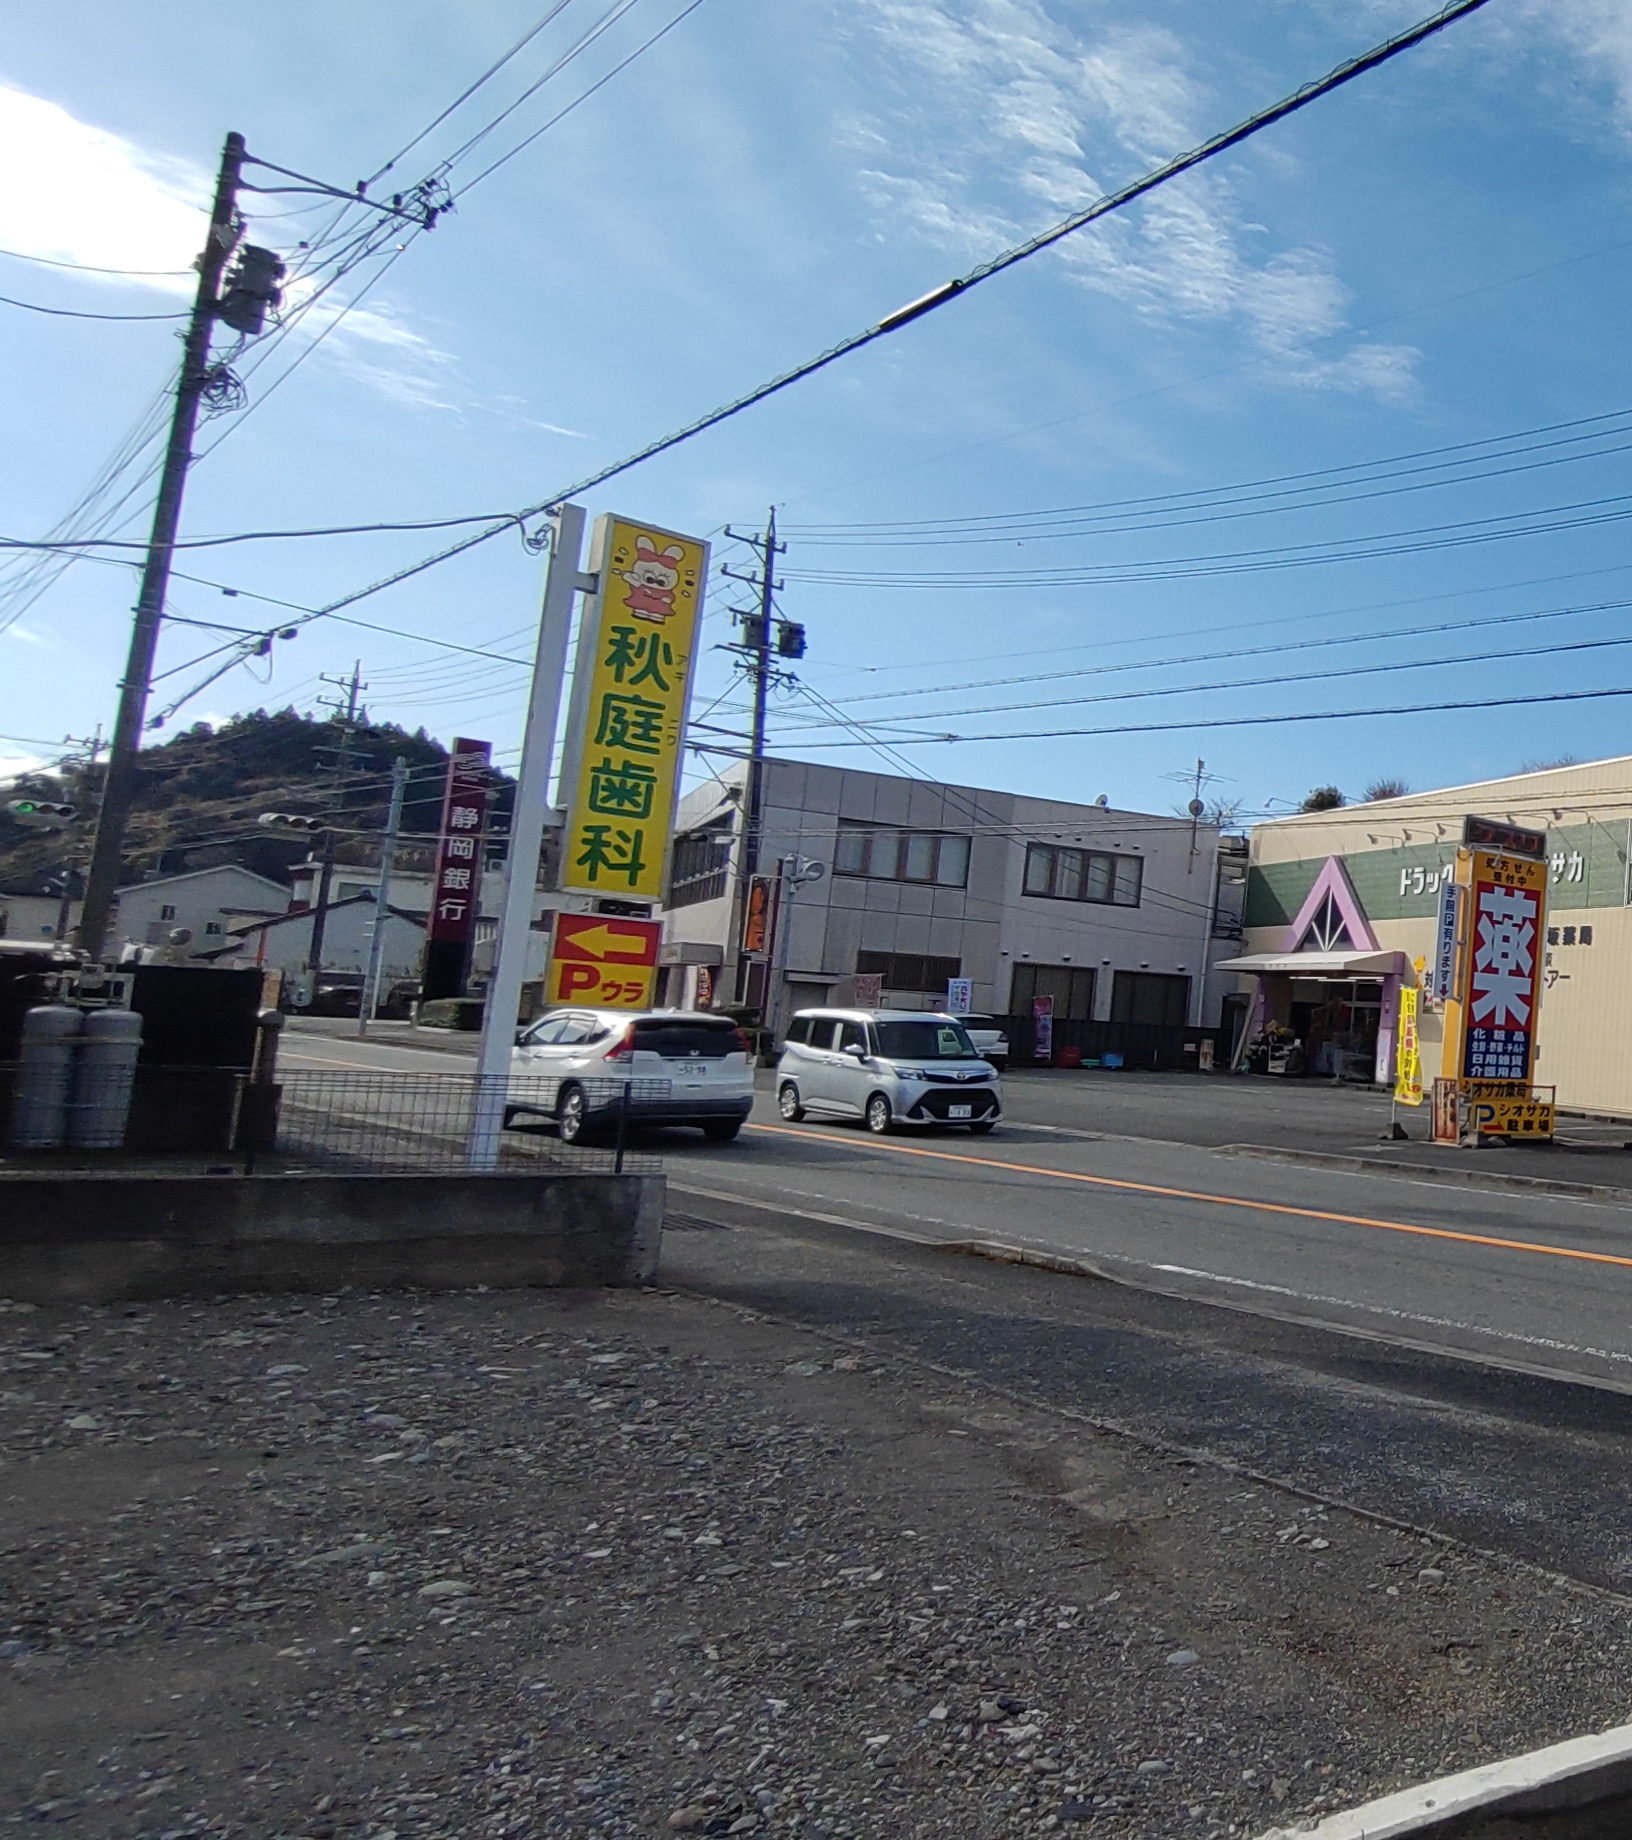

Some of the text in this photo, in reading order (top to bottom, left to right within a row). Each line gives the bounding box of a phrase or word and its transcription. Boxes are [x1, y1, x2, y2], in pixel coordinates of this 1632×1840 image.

[576, 625, 673, 887] 秋庭歯科
[439, 806, 479, 921] 静岡銀行
[1471, 885, 1537, 1026] 薬
[557, 963, 601, 1000] P
[601, 980, 644, 1003] ウラ
[1472, 1027, 1525, 1042] 化粧品
[1472, 1053, 1523, 1066] 日用雑貨
[1499, 1104, 1550, 1117] シオサカ
[1507, 1119, 1549, 1132] 駐車場
